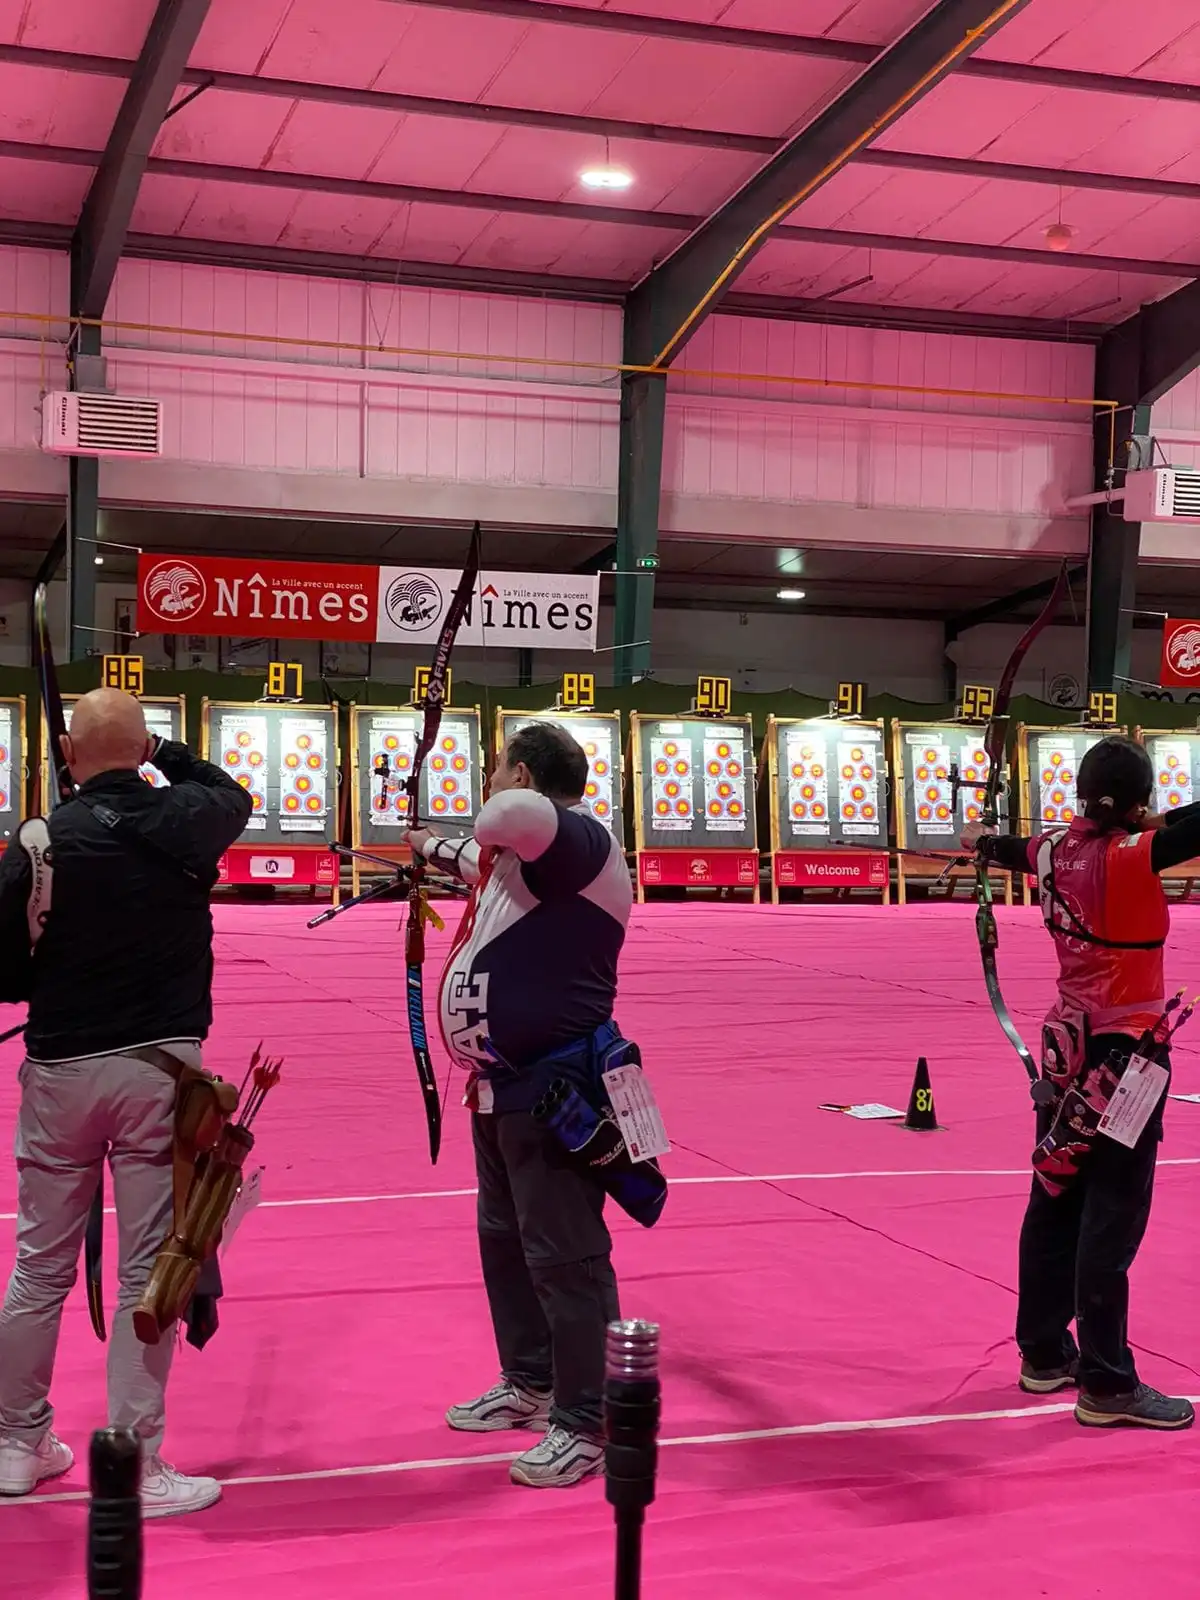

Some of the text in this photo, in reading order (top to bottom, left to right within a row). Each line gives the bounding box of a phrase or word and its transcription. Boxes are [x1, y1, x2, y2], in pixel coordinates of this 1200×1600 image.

[213, 572, 369, 623] Nîmes
[272, 578, 281, 586] La
[282, 578, 302, 587] Ville
[336, 583, 364, 591] accent
[503, 589, 512, 597] La
[513, 589, 531, 598] Ville
[563, 592, 589, 600] accent
[434, 628, 454, 678] FIVICS
[106, 657, 141, 690] 86
[269, 662, 303, 696] 87
[563, 673, 595, 705] 89
[700, 678, 729, 711] 90
[838, 683, 862, 714] 91
[965, 687, 993, 718] 92
[1090, 692, 1118, 722] 93
[804, 863, 861, 876] Welcome
[916, 1088, 933, 1112] 87
